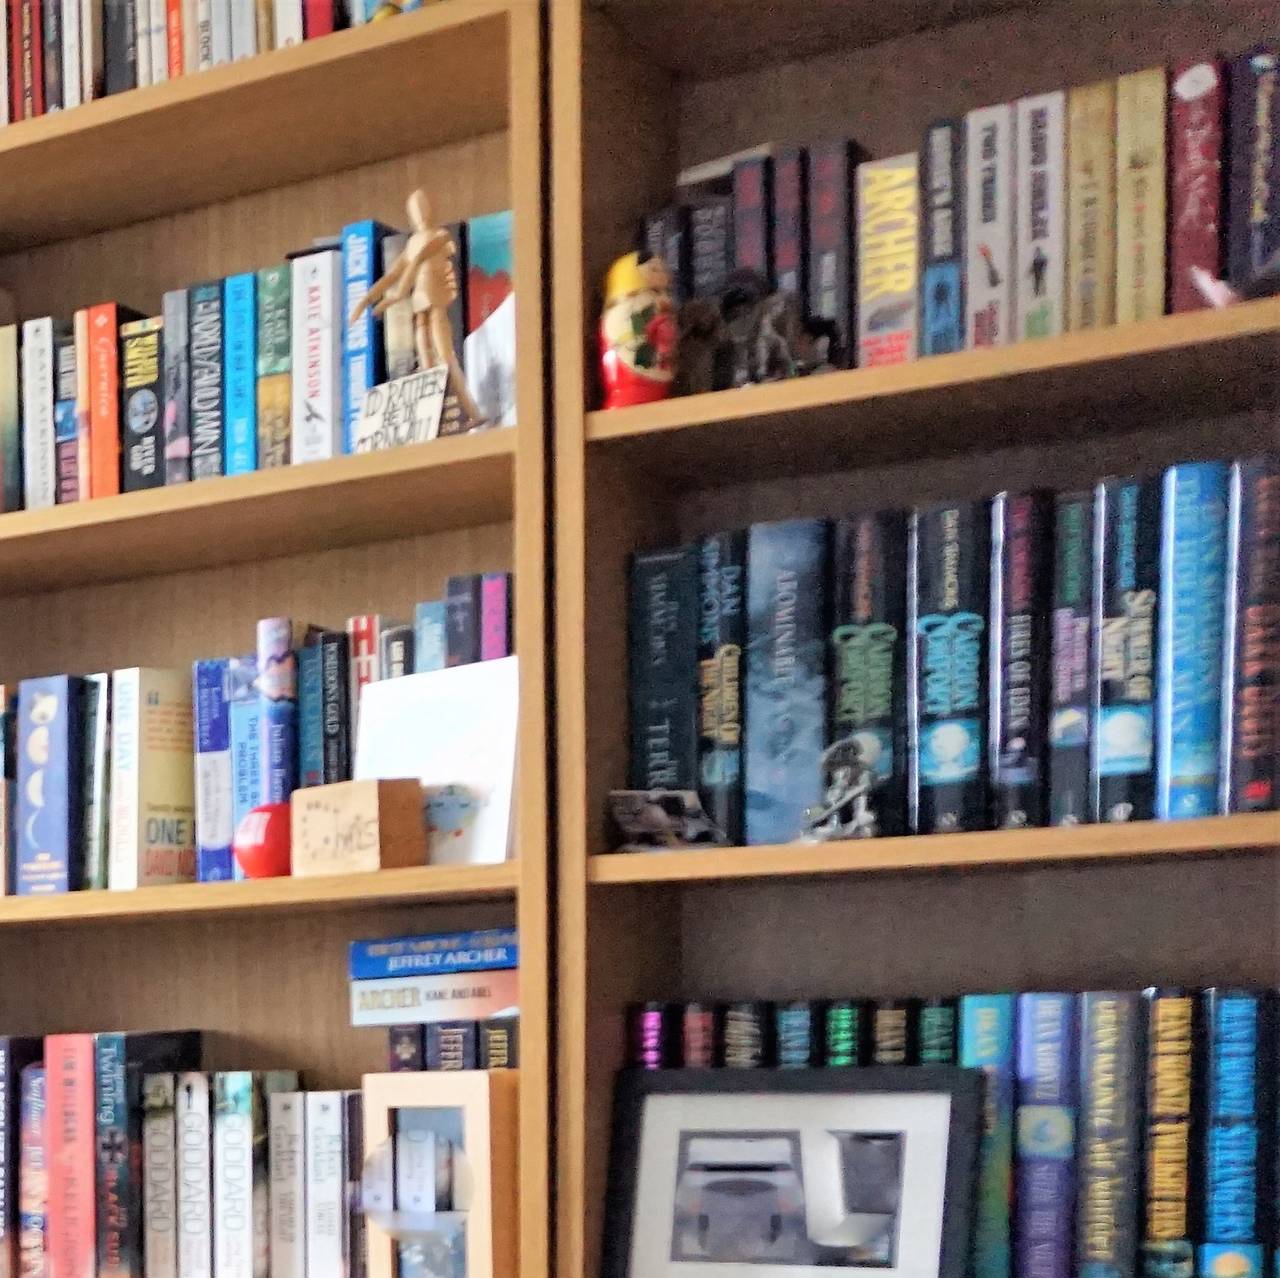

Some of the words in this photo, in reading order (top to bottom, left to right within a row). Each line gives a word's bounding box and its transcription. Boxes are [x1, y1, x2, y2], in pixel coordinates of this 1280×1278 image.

[862, 166, 918, 302] ARCHER
[306, 285, 320, 320] KATE
[306, 328, 321, 399] ATKINSON
[721, 566, 742, 615] DAN
[1008, 614, 1031, 656] FIRES
[955, 613, 984, 709] CARRION
[1008, 662, 1031, 683] OF
[248, 717, 260, 740] THE
[1008, 687, 1031, 729] EDEN
[236, 742, 248, 806] PROBLEM
[248, 745, 260, 783] THREE
[648, 720, 672, 790] TERR
[146, 817, 188, 844] ONE
[387, 953, 443, 971] JEFFREY
[444, 947, 509, 966] ARCHER
[359, 986, 422, 1010] ARCHER
[451, 987, 469, 1000] AND
[98, 1047, 117, 1125] Twining
[149, 1118, 172, 1233] GODDARD
[183, 1113, 206, 1237] GODDARD
[222, 1113, 246, 1231] GODDARD
